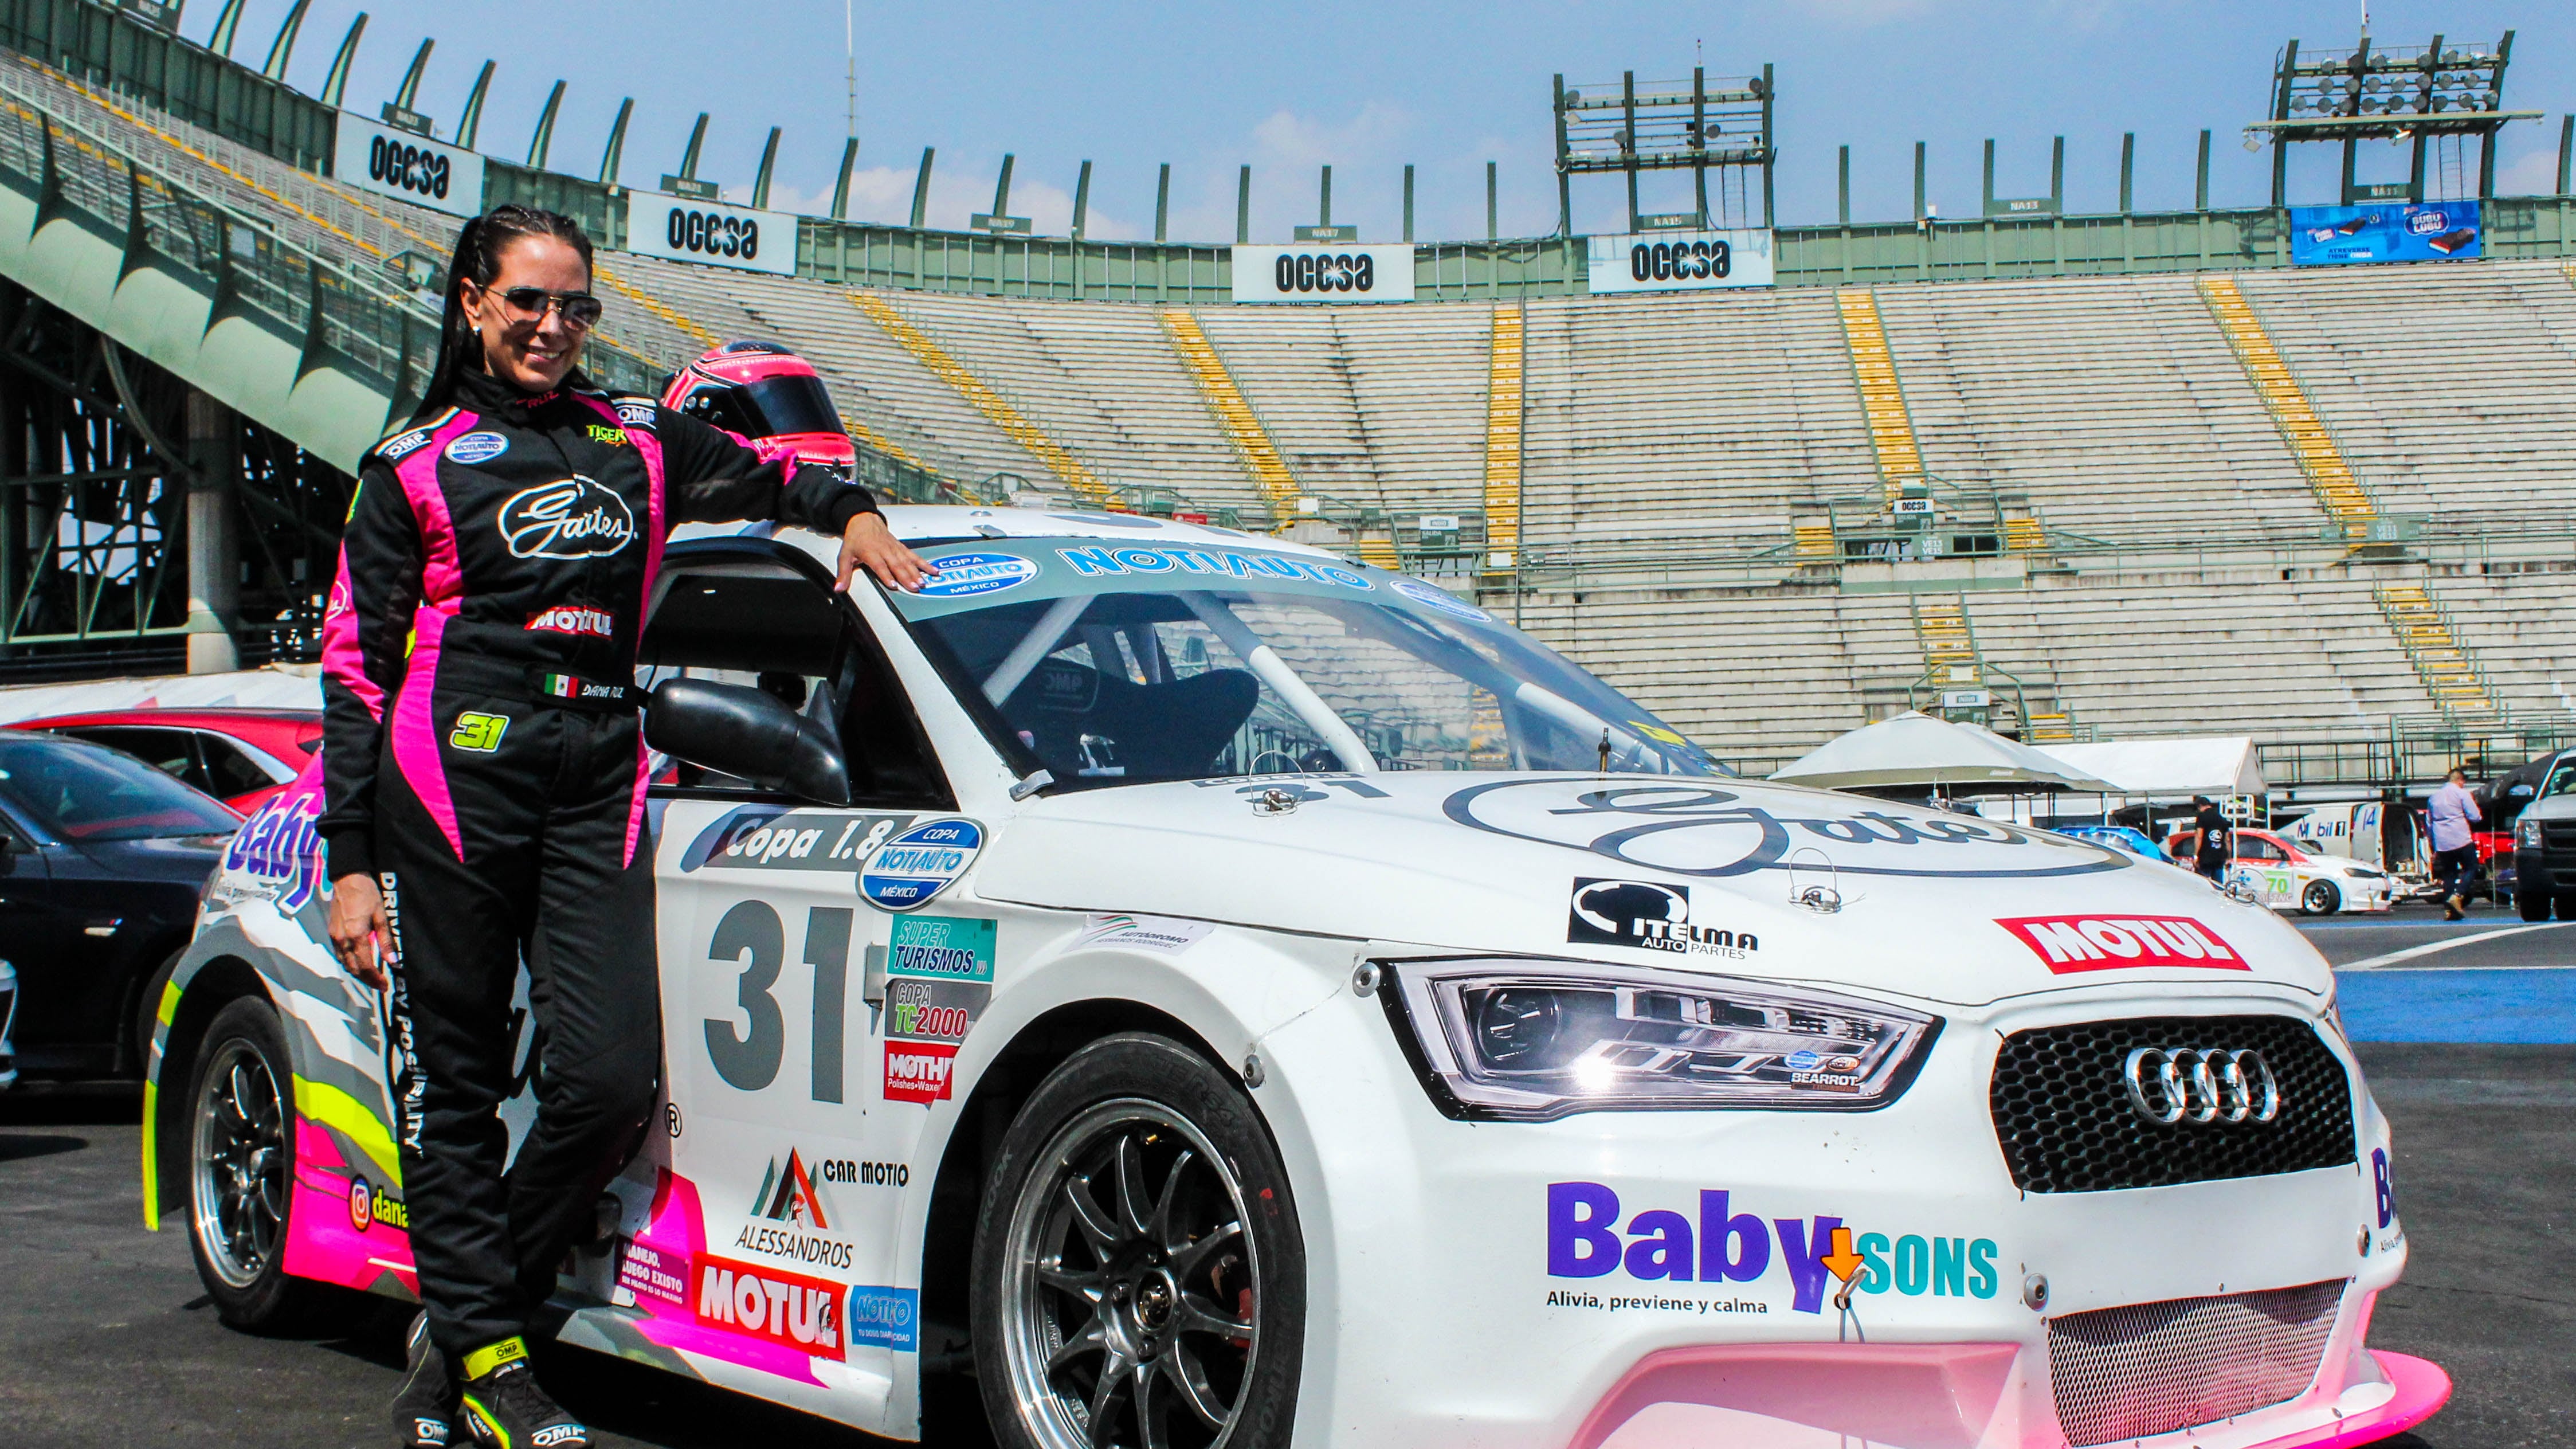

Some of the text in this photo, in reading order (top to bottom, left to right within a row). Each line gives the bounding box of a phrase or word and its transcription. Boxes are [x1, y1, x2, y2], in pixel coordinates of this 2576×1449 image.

[2009, 201, 2038, 211] NA13
[1653, 216, 1682, 226] NA15
[2412, 213, 2441, 225] BUBU
[2413, 222, 2442, 233] LUBU
[1311, 229, 1339, 238] NA17
[617, 408, 656, 423] OMP
[586, 424, 628, 442] TIGER
[389, 432, 426, 457] OMP
[1922, 547, 1943, 555] VE15
[939, 557, 984, 569] COPA
[950, 581, 999, 594] MÉXICO
[581, 684, 610, 698] DANA
[450, 711, 509, 752] 31
[922, 828, 960, 841] COPA
[2297, 821, 2333, 838] Mbil
[727, 818, 895, 864] Copa 1.8
[880, 884, 919, 899] MÉXICO
[2266, 878, 2288, 894] 70
[897, 921, 951, 947] SUPER
[2024, 919, 2232, 962] MOTUL
[1641, 937, 1746, 960] AUTO PARTES
[894, 946, 975, 974] TURISMOS
[704, 899, 854, 1104] 31
[896, 983, 932, 1006] COPA
[895, 1004, 969, 1037] TC2000
[1791, 1072, 1859, 1086] BEARROT
[823, 1159, 909, 1187] CAR MOTIO
[735, 1224, 853, 1270] ALESSANDROS
[1547, 1181, 1998, 1315] Baby SONS
[652, 1270, 683, 1293] EXISTO
[699, 1265, 837, 1348] MOTUL
[1547, 1290, 1768, 1315] Alivia, previene y calma
[496, 1344, 517, 1358] OMP
